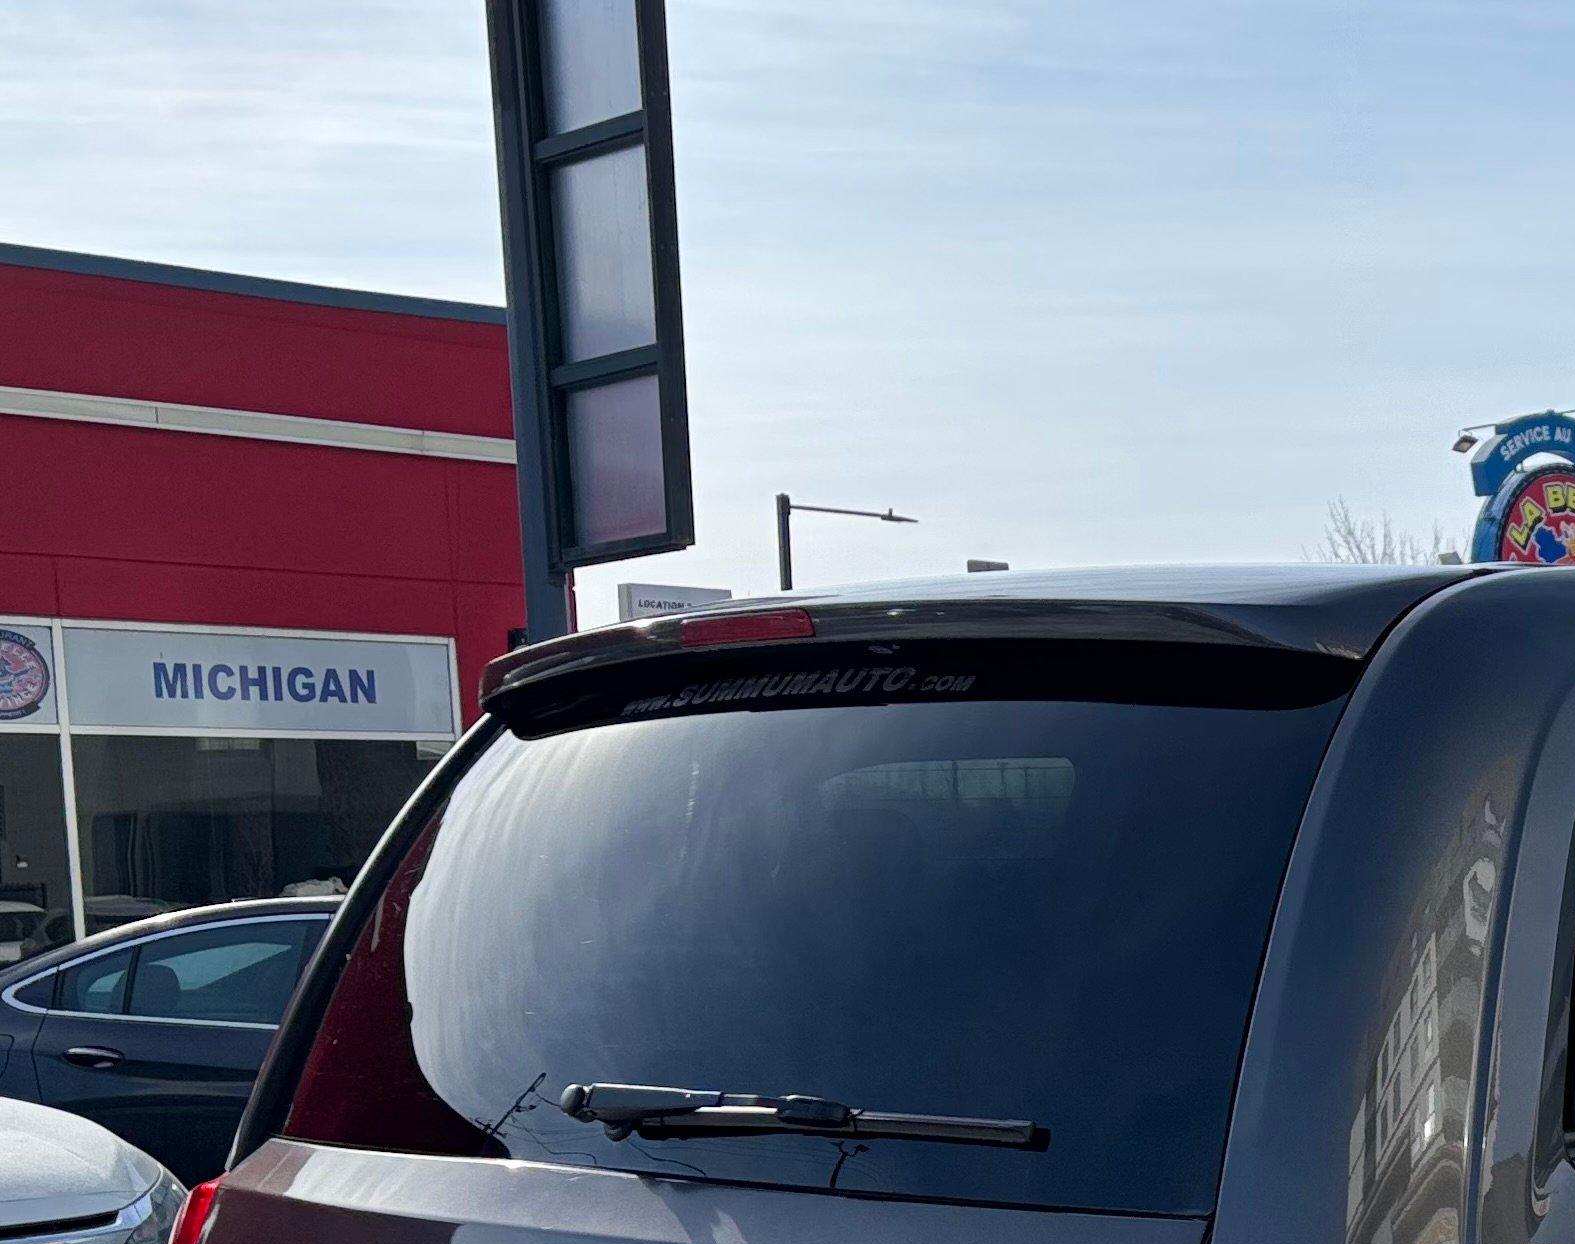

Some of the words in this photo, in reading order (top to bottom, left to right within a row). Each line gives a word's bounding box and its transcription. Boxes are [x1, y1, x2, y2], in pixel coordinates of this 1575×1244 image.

[1499, 425, 1551, 461] SERVICE
[1554, 426, 1571, 443] AU
[1508, 496, 1546, 550] LA
[153, 661, 378, 704] MICHIGAN
